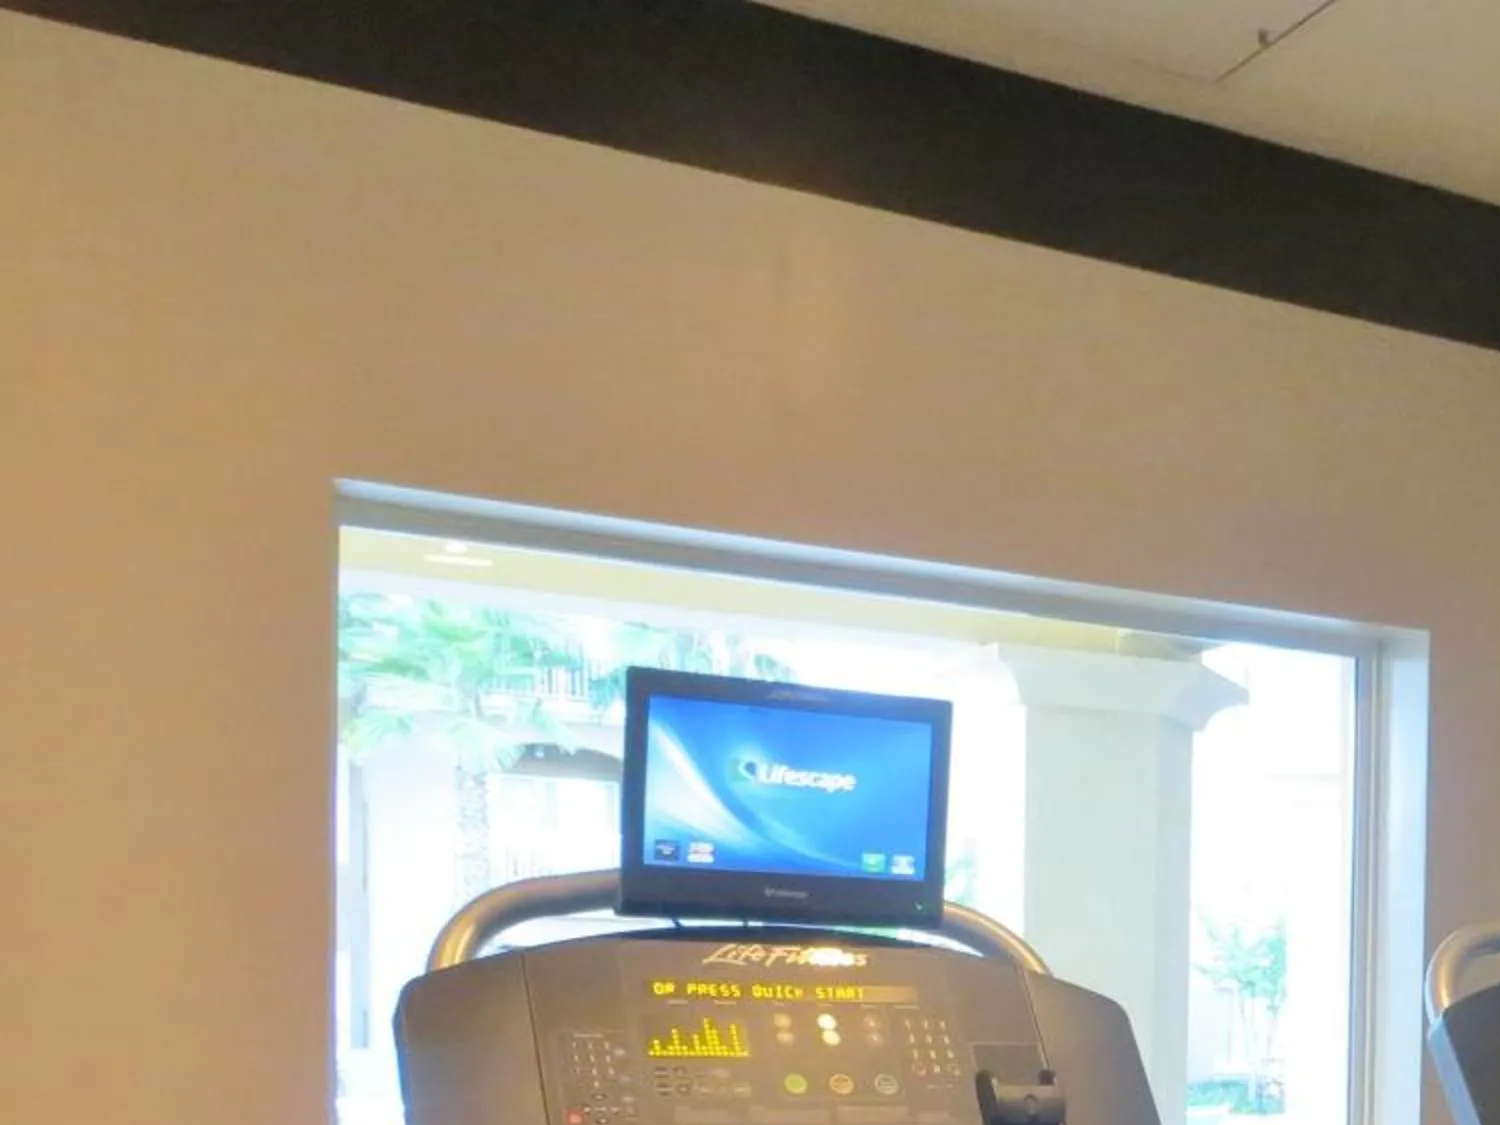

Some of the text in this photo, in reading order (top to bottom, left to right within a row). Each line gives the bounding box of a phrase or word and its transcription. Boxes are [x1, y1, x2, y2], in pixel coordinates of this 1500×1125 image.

[702, 943, 868, 968] Life Fits
[653, 980, 675, 996] OR
[686, 983, 741, 998] PRESS
[751, 984, 804, 999] QUICK
